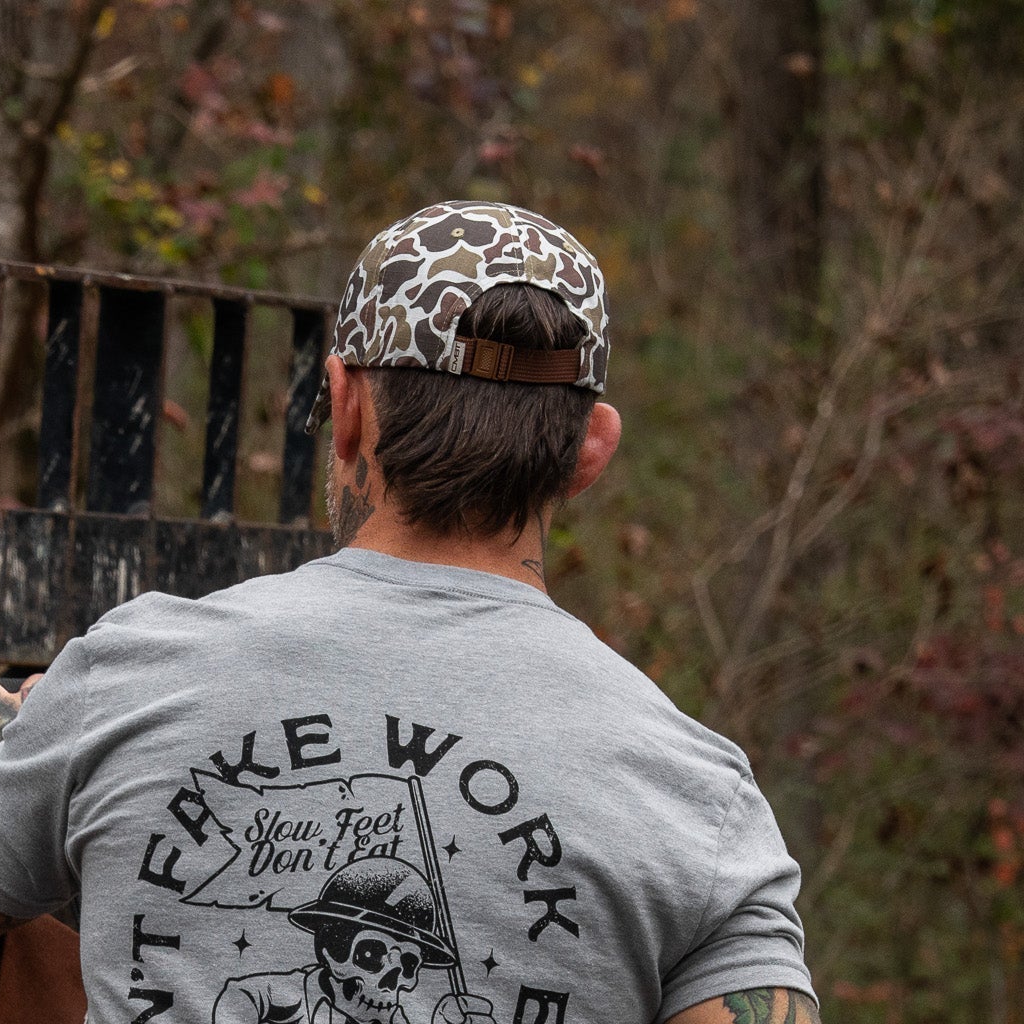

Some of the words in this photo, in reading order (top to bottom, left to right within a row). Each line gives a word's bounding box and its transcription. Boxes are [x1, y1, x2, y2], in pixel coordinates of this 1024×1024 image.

[138, 714, 341, 896] FAKE
[385, 714, 580, 942] WORK
[245, 808, 323, 842] Slow
[335, 803, 405, 842] Feet
[248, 839, 340, 877] Don't
[348, 835, 403, 864] Eat
